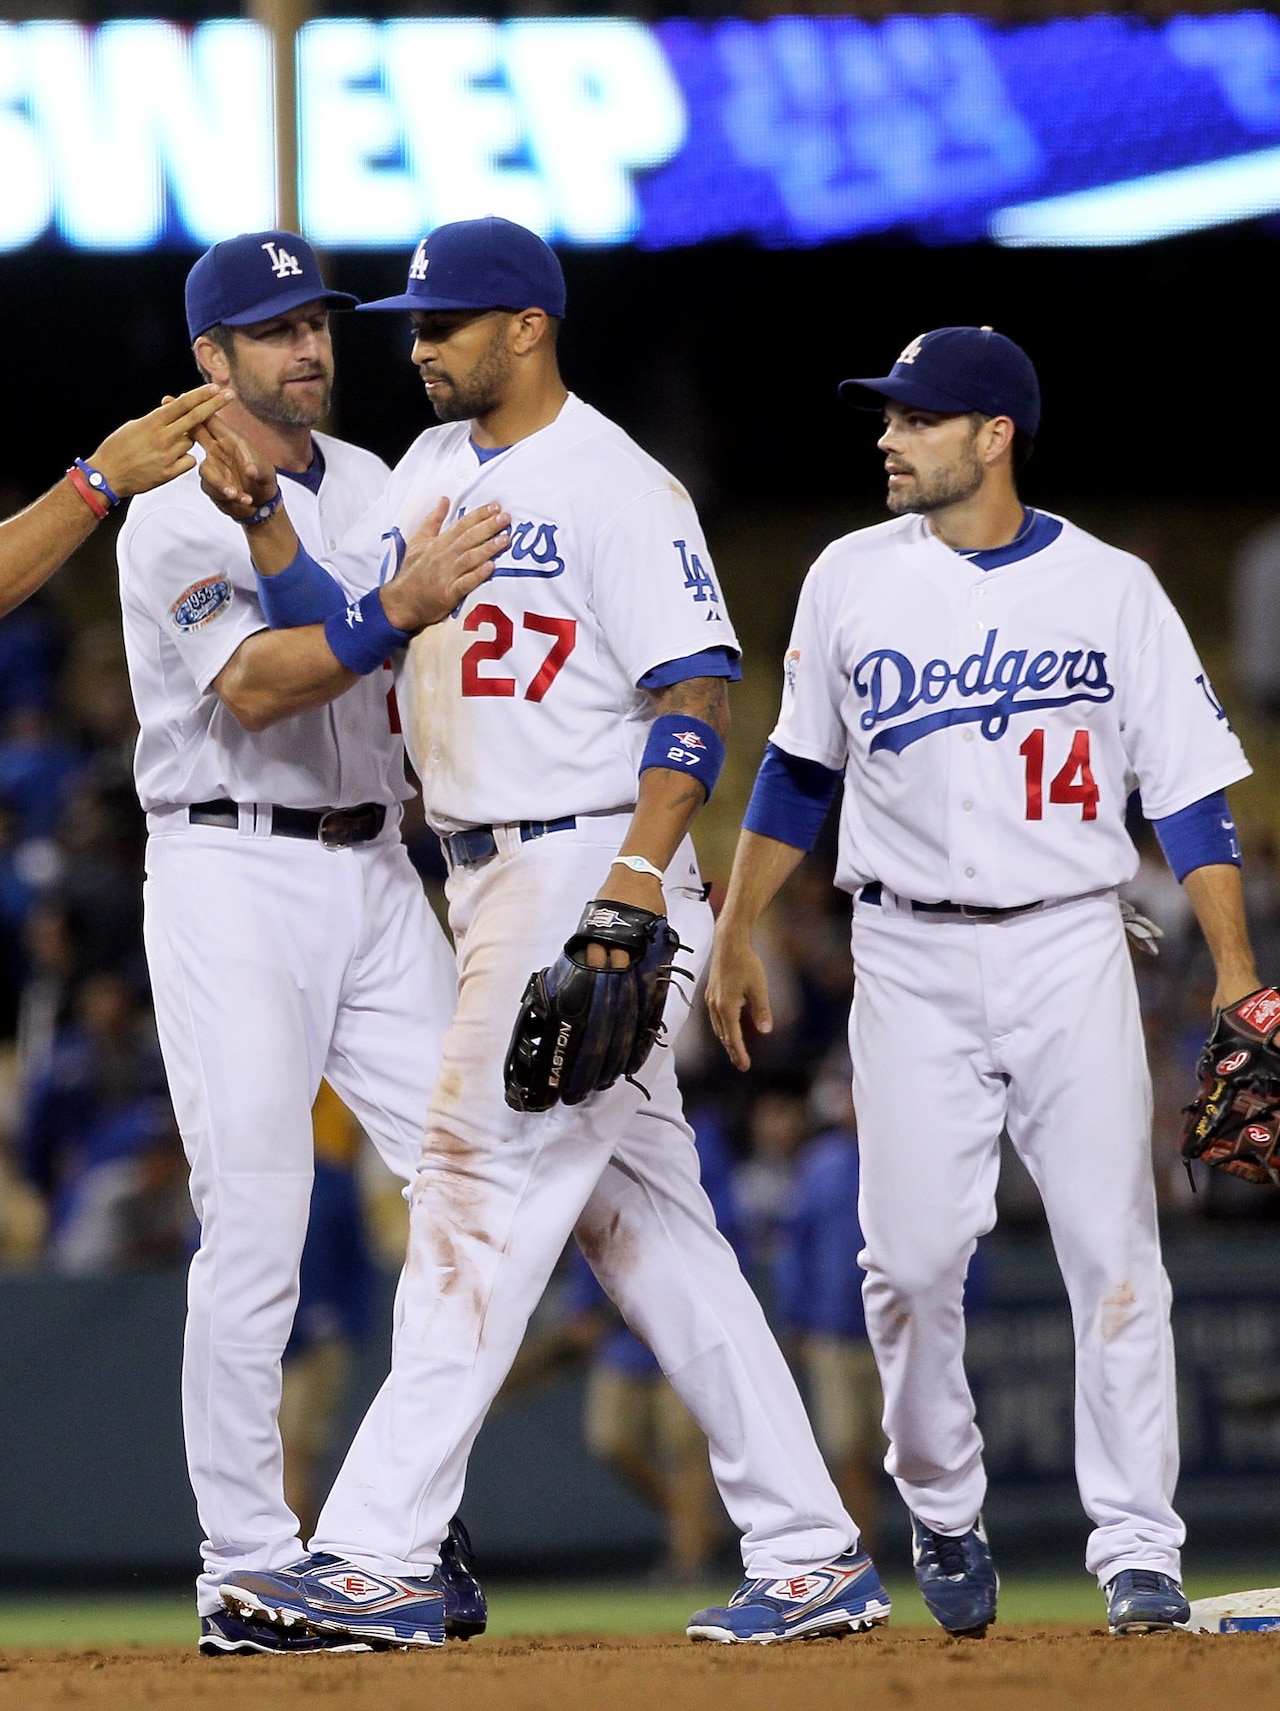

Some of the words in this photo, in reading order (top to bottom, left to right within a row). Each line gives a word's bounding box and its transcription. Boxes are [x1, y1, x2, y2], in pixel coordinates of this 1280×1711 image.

[261, 241, 303, 279] LA
[672, 539, 719, 603] LA
[461, 603, 577, 703] 27
[853, 628, 1114, 756] Dodgers
[666, 746, 701, 766] 27
[1019, 728, 1100, 821] 14
[548, 1021, 573, 1088] EASTON
